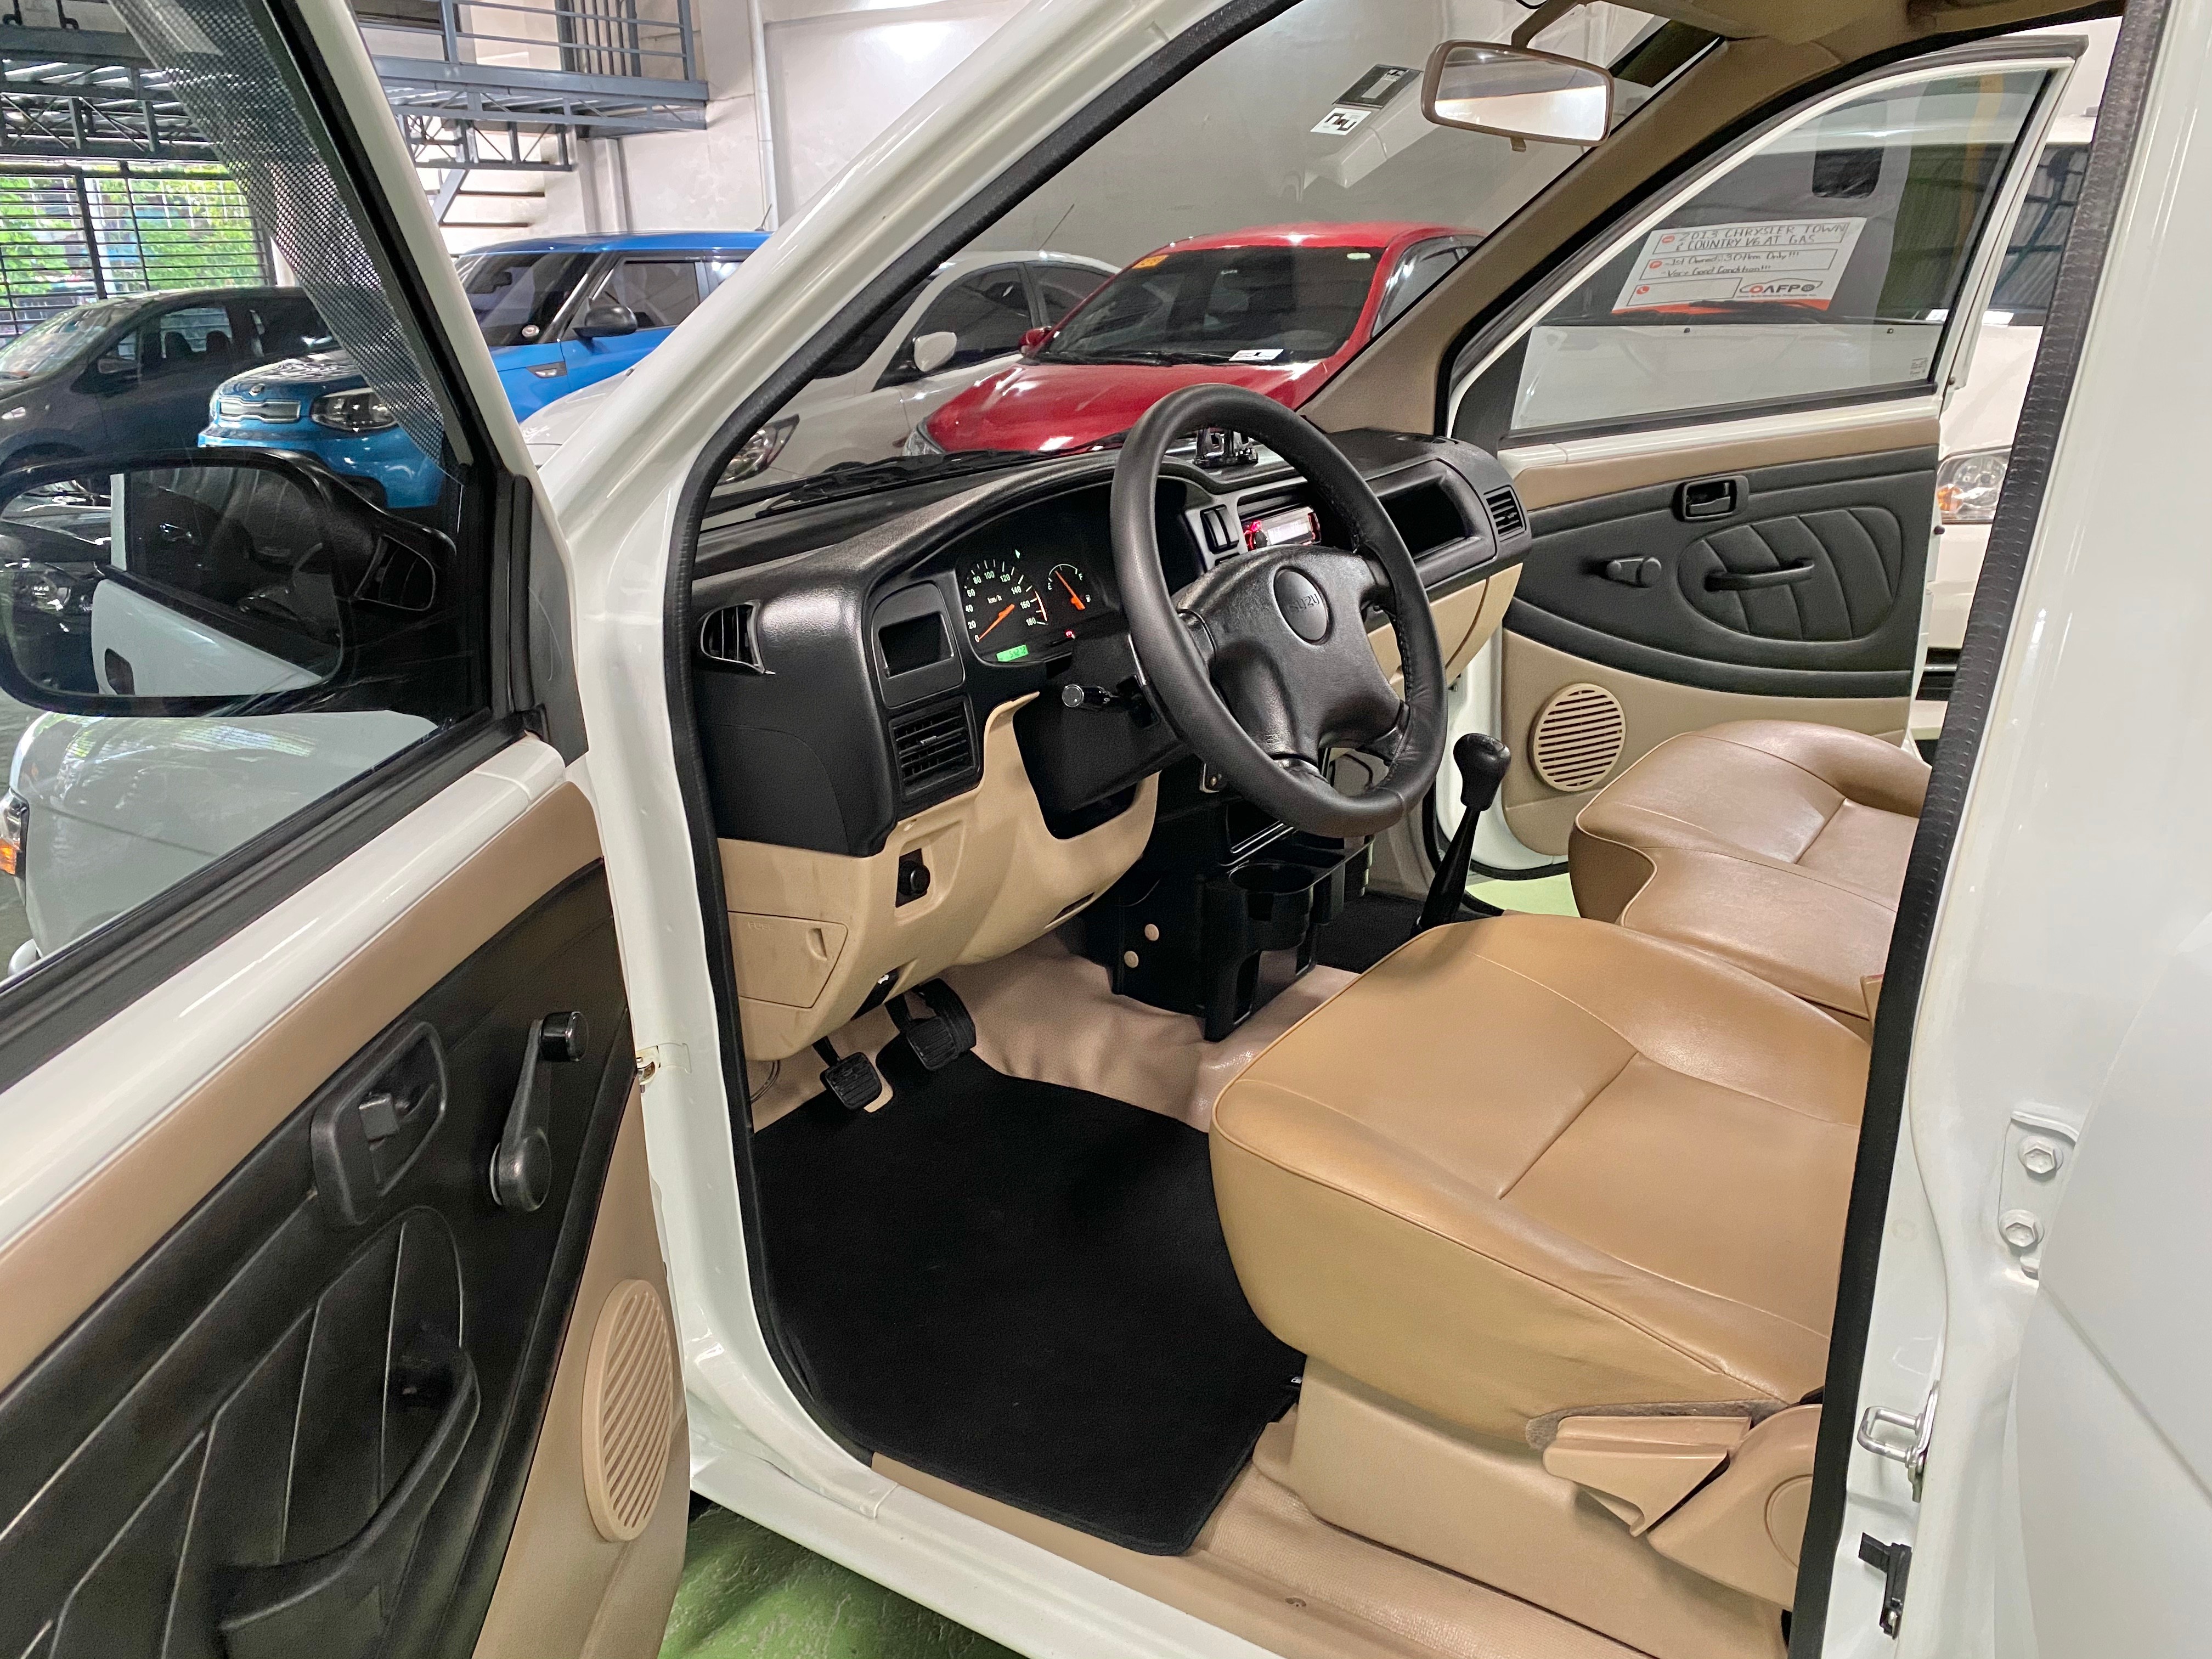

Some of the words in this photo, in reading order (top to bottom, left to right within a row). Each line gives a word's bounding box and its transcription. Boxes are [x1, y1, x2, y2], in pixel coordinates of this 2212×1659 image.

[1679, 230, 1718, 241] 2013
[1725, 225, 1795, 238] CHRYSLER
[1804, 224, 1845, 233] TOWN
[1688, 238, 1741, 251] COUNTRY
[1763, 235, 1781, 245] AT
[1789, 234, 1815, 244] GAS
[984, 571, 995, 579] 100
[1000, 573, 1011, 582] 120
[973, 576, 981, 584] 80
[967, 588, 975, 597] 60
[1011, 585, 1022, 595] 140
[988, 595, 1002, 603] km/h
[965, 605, 974, 613] 40
[1020, 600, 1030, 609] 160
[967, 620, 977, 629] 20
[1026, 617, 1036, 626] 180
[748, 922, 774, 930] FUSE
